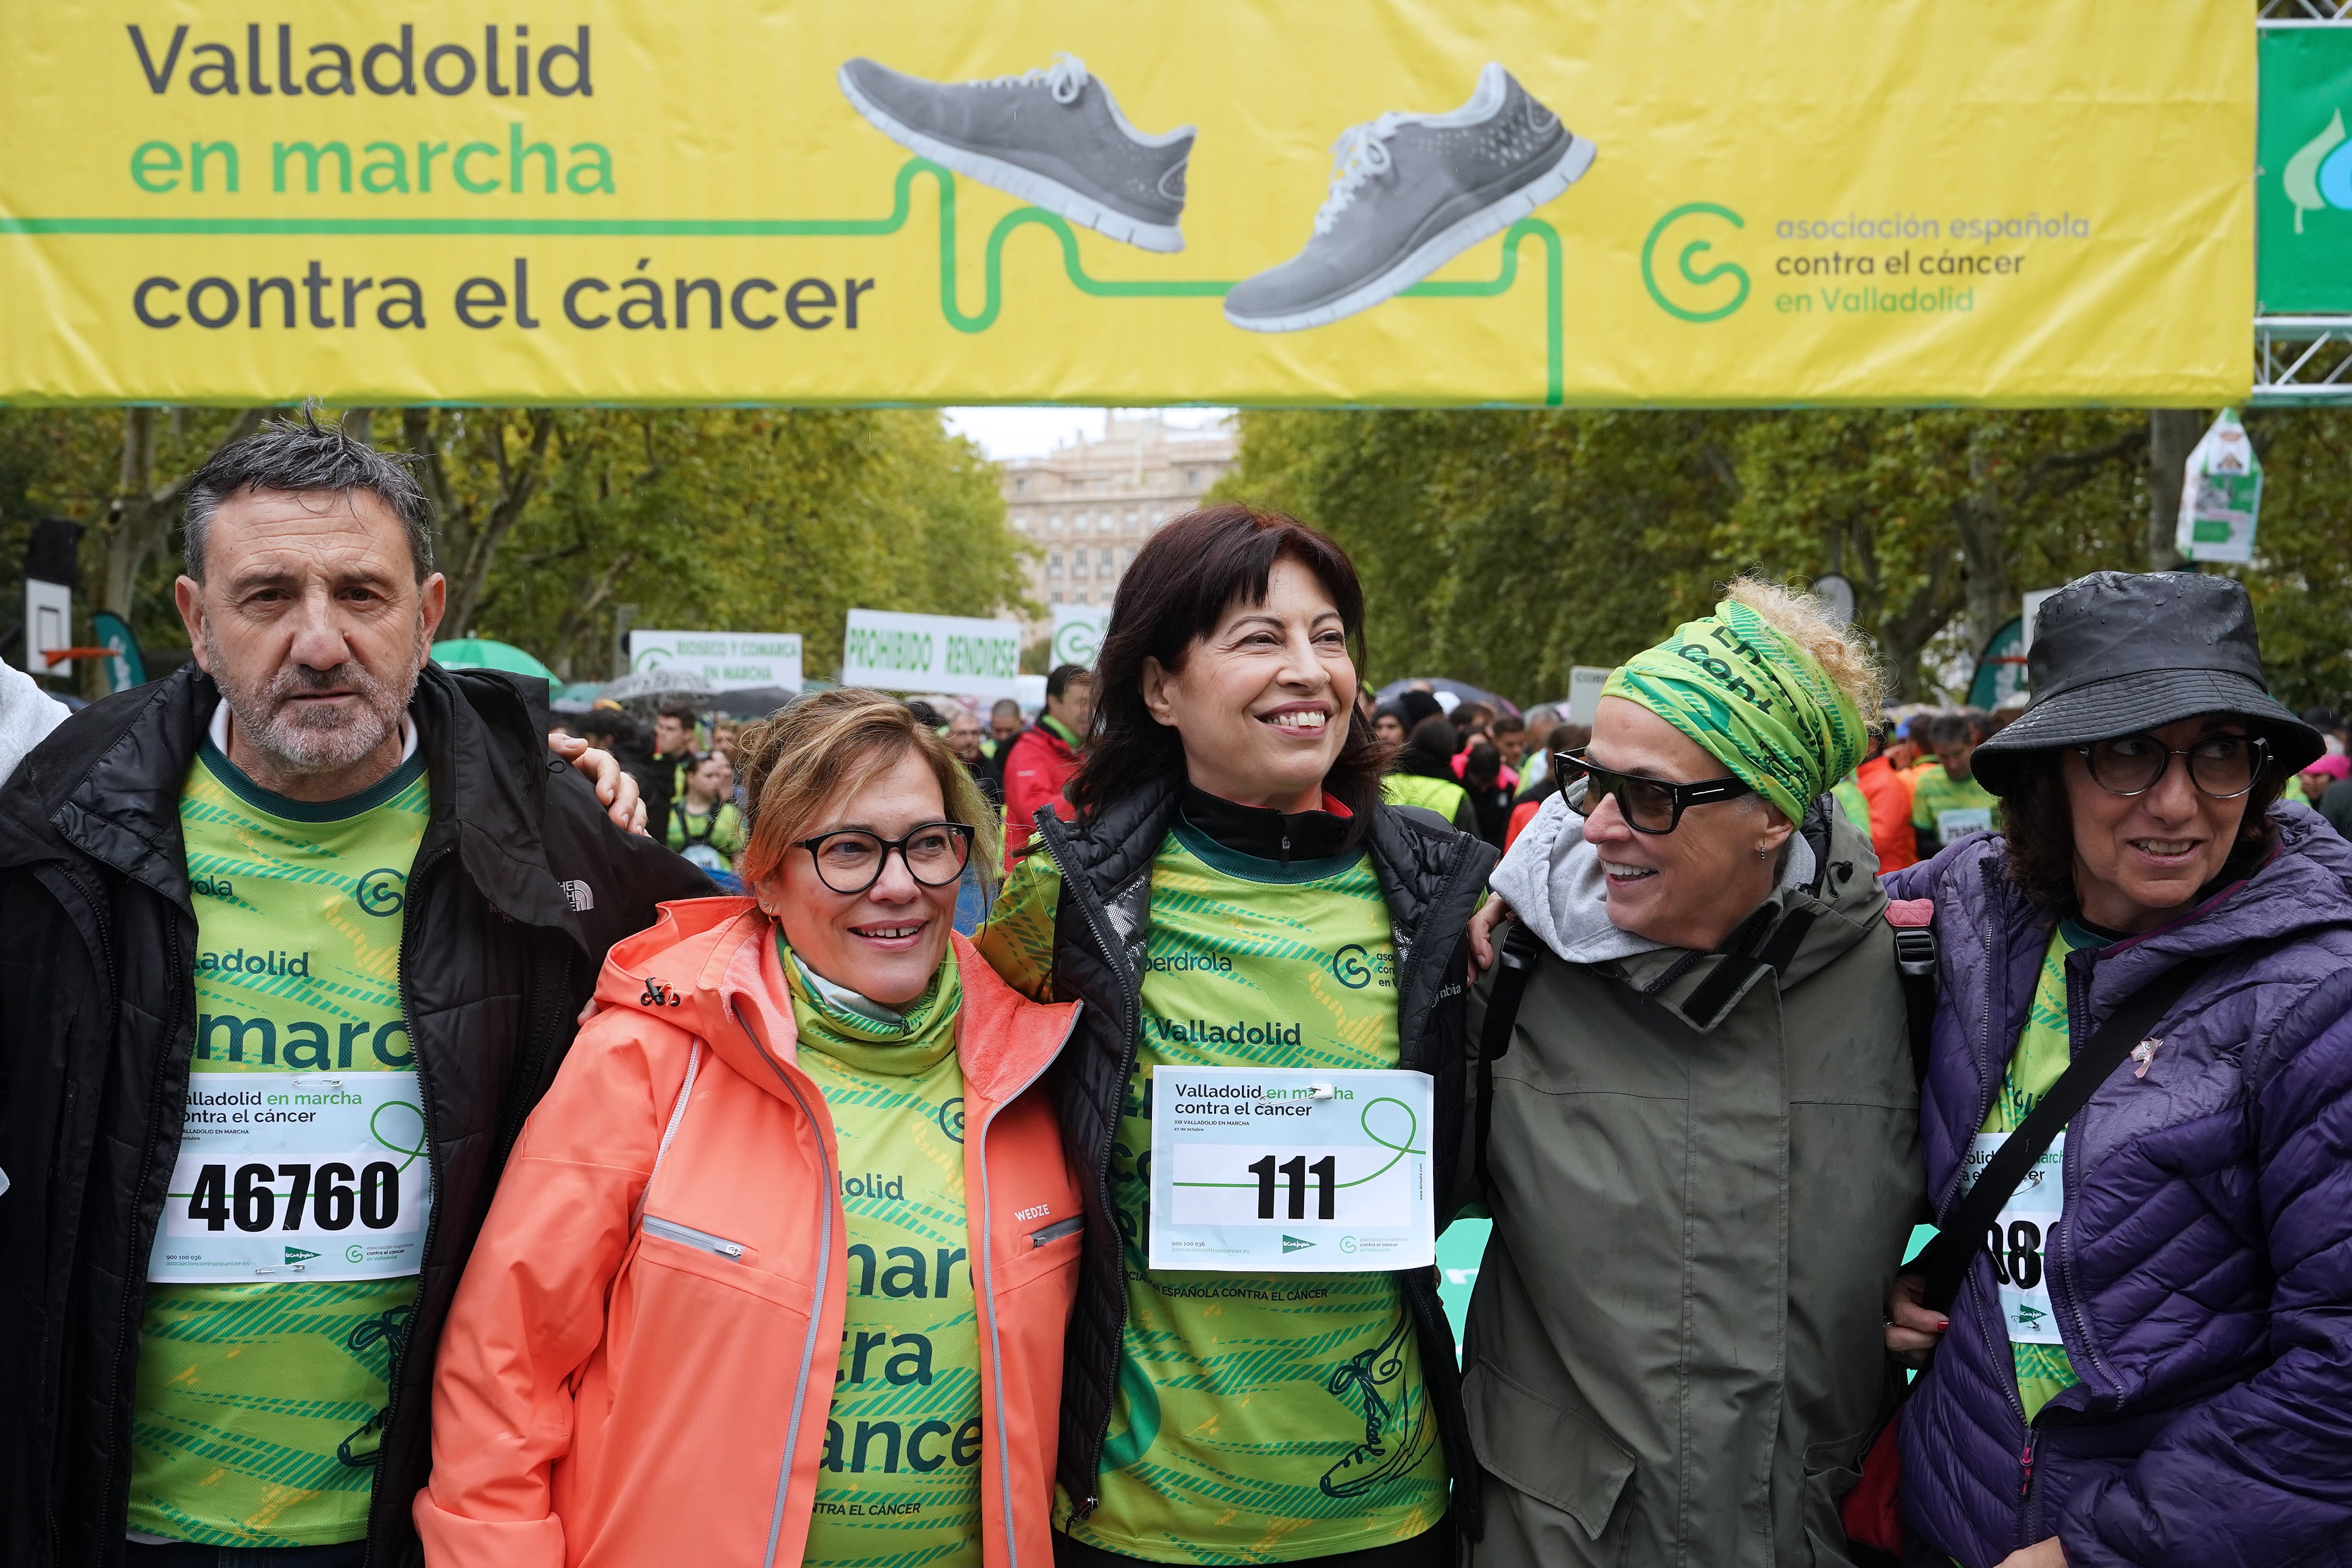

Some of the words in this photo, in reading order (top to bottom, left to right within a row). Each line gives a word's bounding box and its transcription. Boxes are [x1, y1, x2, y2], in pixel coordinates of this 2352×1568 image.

[127, 24, 593, 97] Valladolid
[129, 140, 240, 195] en
[272, 123, 616, 195] marcha
[1776, 213, 1939, 239] asociación
[1949, 212, 2090, 245] española
[1776, 252, 1875, 275] contra
[1885, 251, 1910, 275] el
[1919, 250, 2025, 275] cáncer
[133, 260, 426, 329] contra
[454, 259, 539, 329] el
[562, 259, 875, 329] cáncer
[1776, 291, 1812, 312] en
[1821, 287, 1974, 312] Valladolid
[741, 642, 796, 656] COMARCA
[850, 628, 933, 673] PROHIBIDO
[945, 635, 1016, 678] RENDIRSE
[724, 666, 772, 679] MARCHA
[1678, 644, 1774, 715] cont
[197, 949, 309, 977] adolid
[1145, 952, 1232, 972] berdrola
[197, 1014, 413, 1070] marc
[1155, 1018, 1301, 1046] Valladolid
[185, 1091, 262, 1105] alladolid
[267, 1095, 288, 1105] en
[295, 1091, 362, 1105] marcha
[1175, 1084, 1261, 1098] Valladolid
[1266, 1089, 1286, 1099] en
[1292, 1087, 1354, 1100] maha
[184, 1109, 227, 1123] ontra
[232, 1109, 249, 1123] el
[254, 1109, 316, 1122] cáncer
[1175, 1102, 1230, 1114] contra
[1234, 1102, 1250, 1115] el
[188, 1161, 399, 1232] 46760
[1248, 1155, 1335, 1220] 111
[1015, 1204, 1050, 1222] WEDZE
[1162, 1286, 1220, 1298] ESPAÑOLA
[1221, 1288, 1268, 1300] CONTRA
[1271, 1292, 1285, 1301] EL
[1287, 1289, 1328, 1301] CÁNCER
[812, 1502, 846, 1515] NTRA
[849, 1504, 865, 1515] EL
[869, 1502, 921, 1515] CÁNCER
